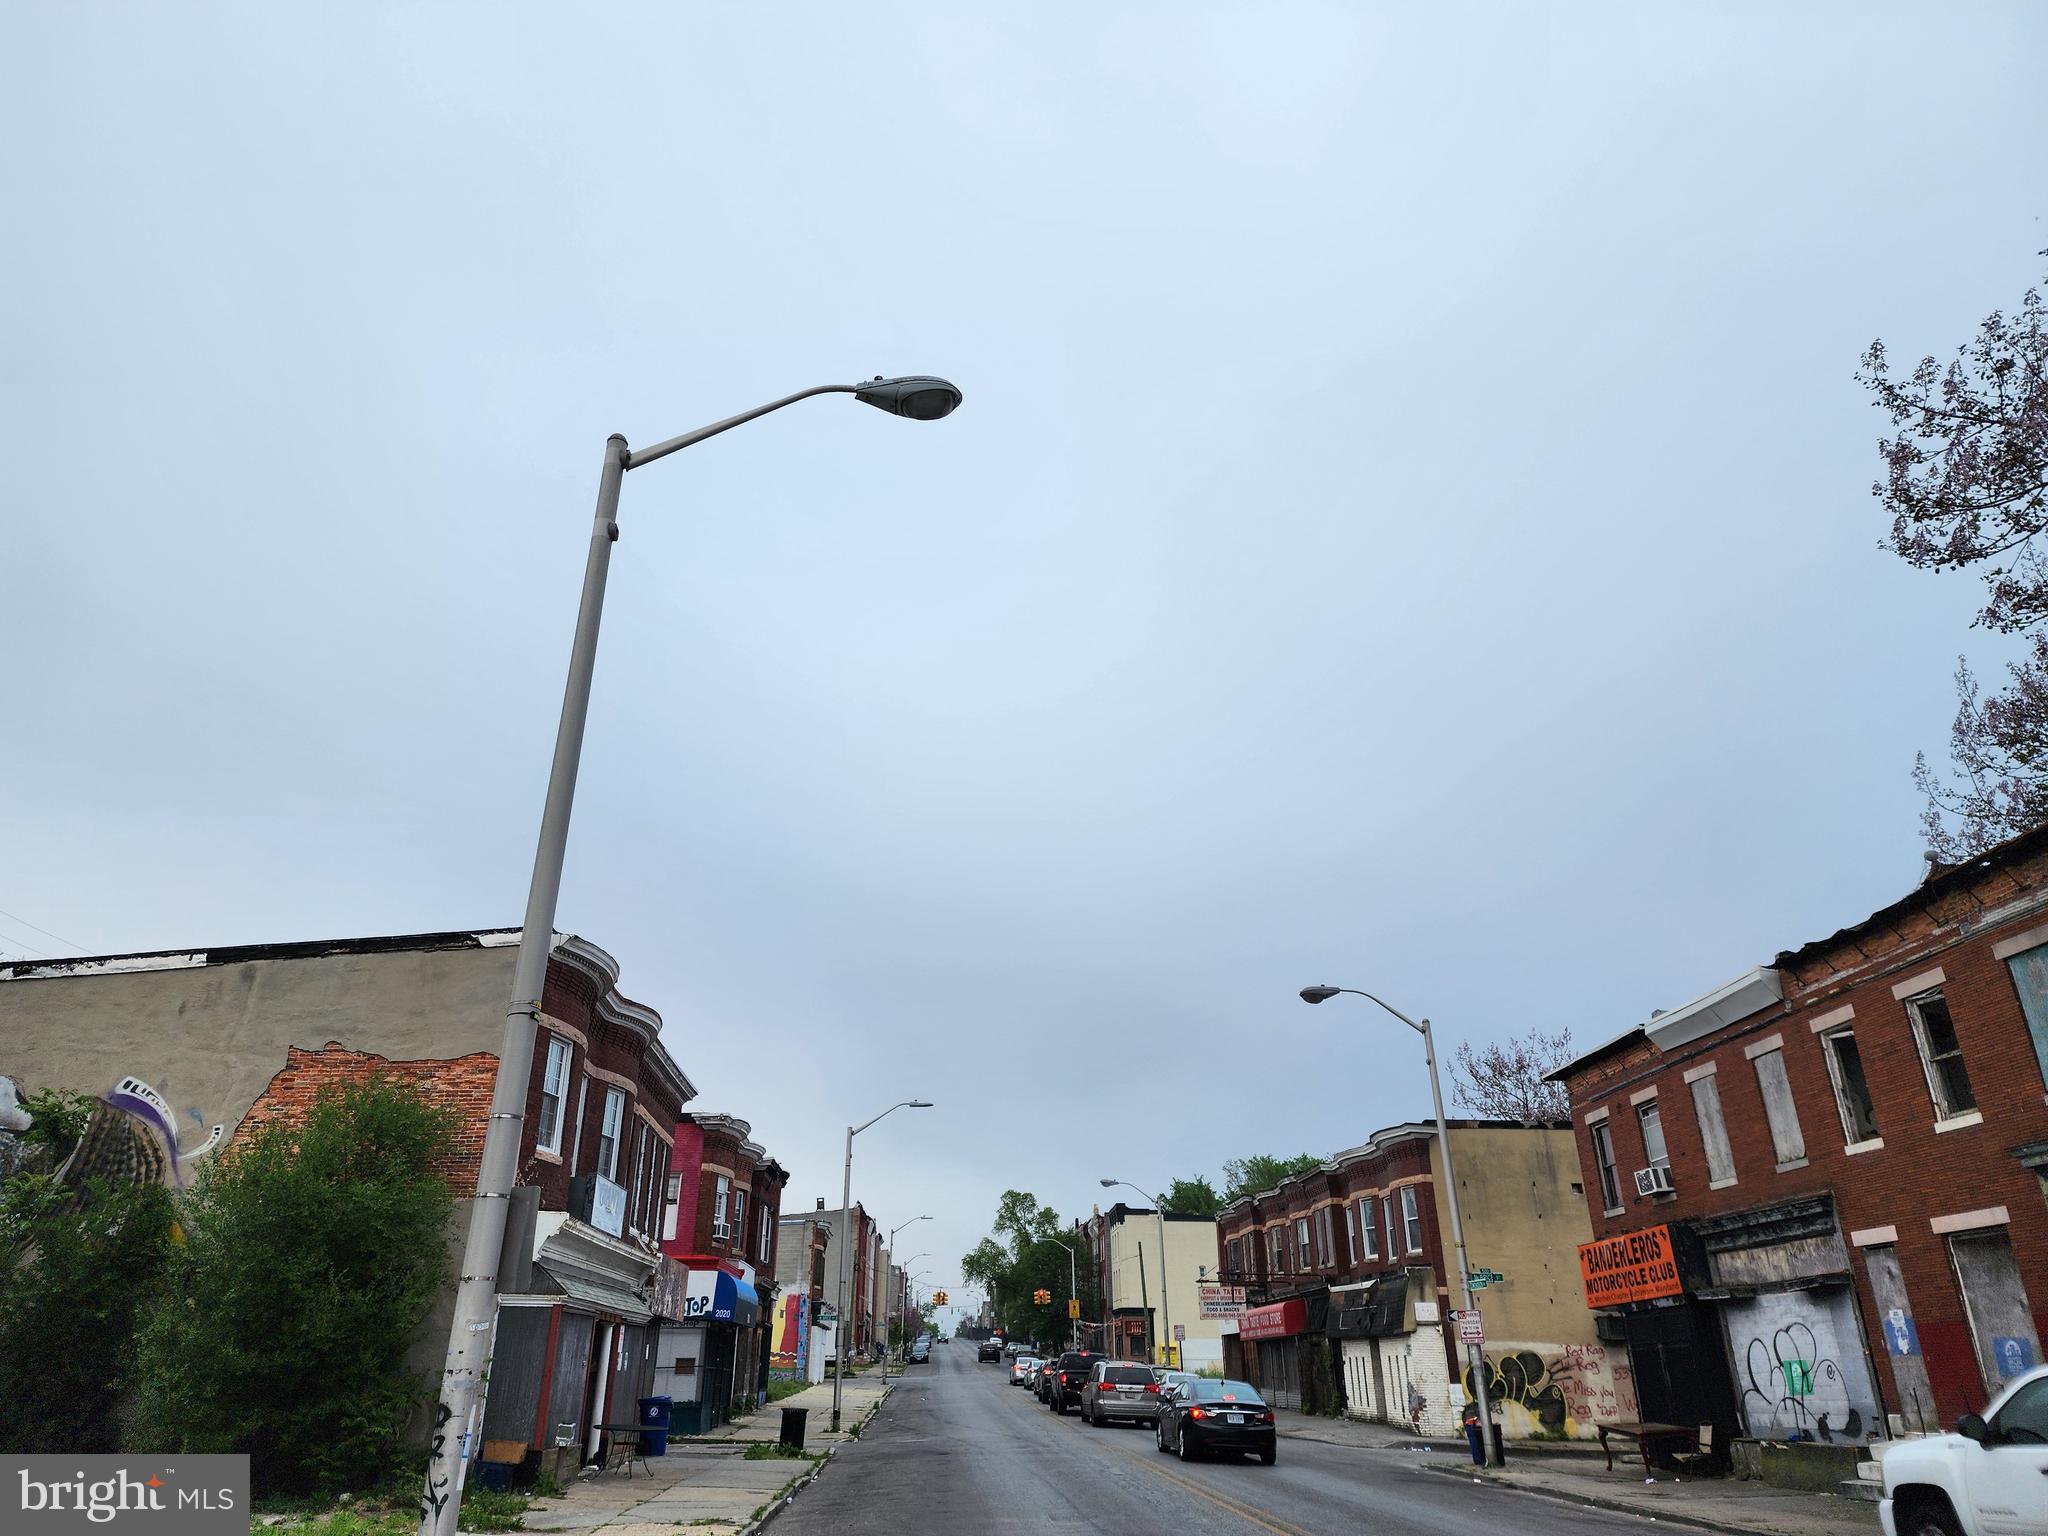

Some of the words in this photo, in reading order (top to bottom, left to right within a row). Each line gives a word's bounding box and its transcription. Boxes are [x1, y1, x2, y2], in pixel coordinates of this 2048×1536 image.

[1586, 1231, 1662, 1275] BANDERLEROS
[1586, 1268, 1648, 1295] MOTORCYCLE
[1648, 1261, 1675, 1284] CLUB
[715, 1309, 731, 1319] 2020
